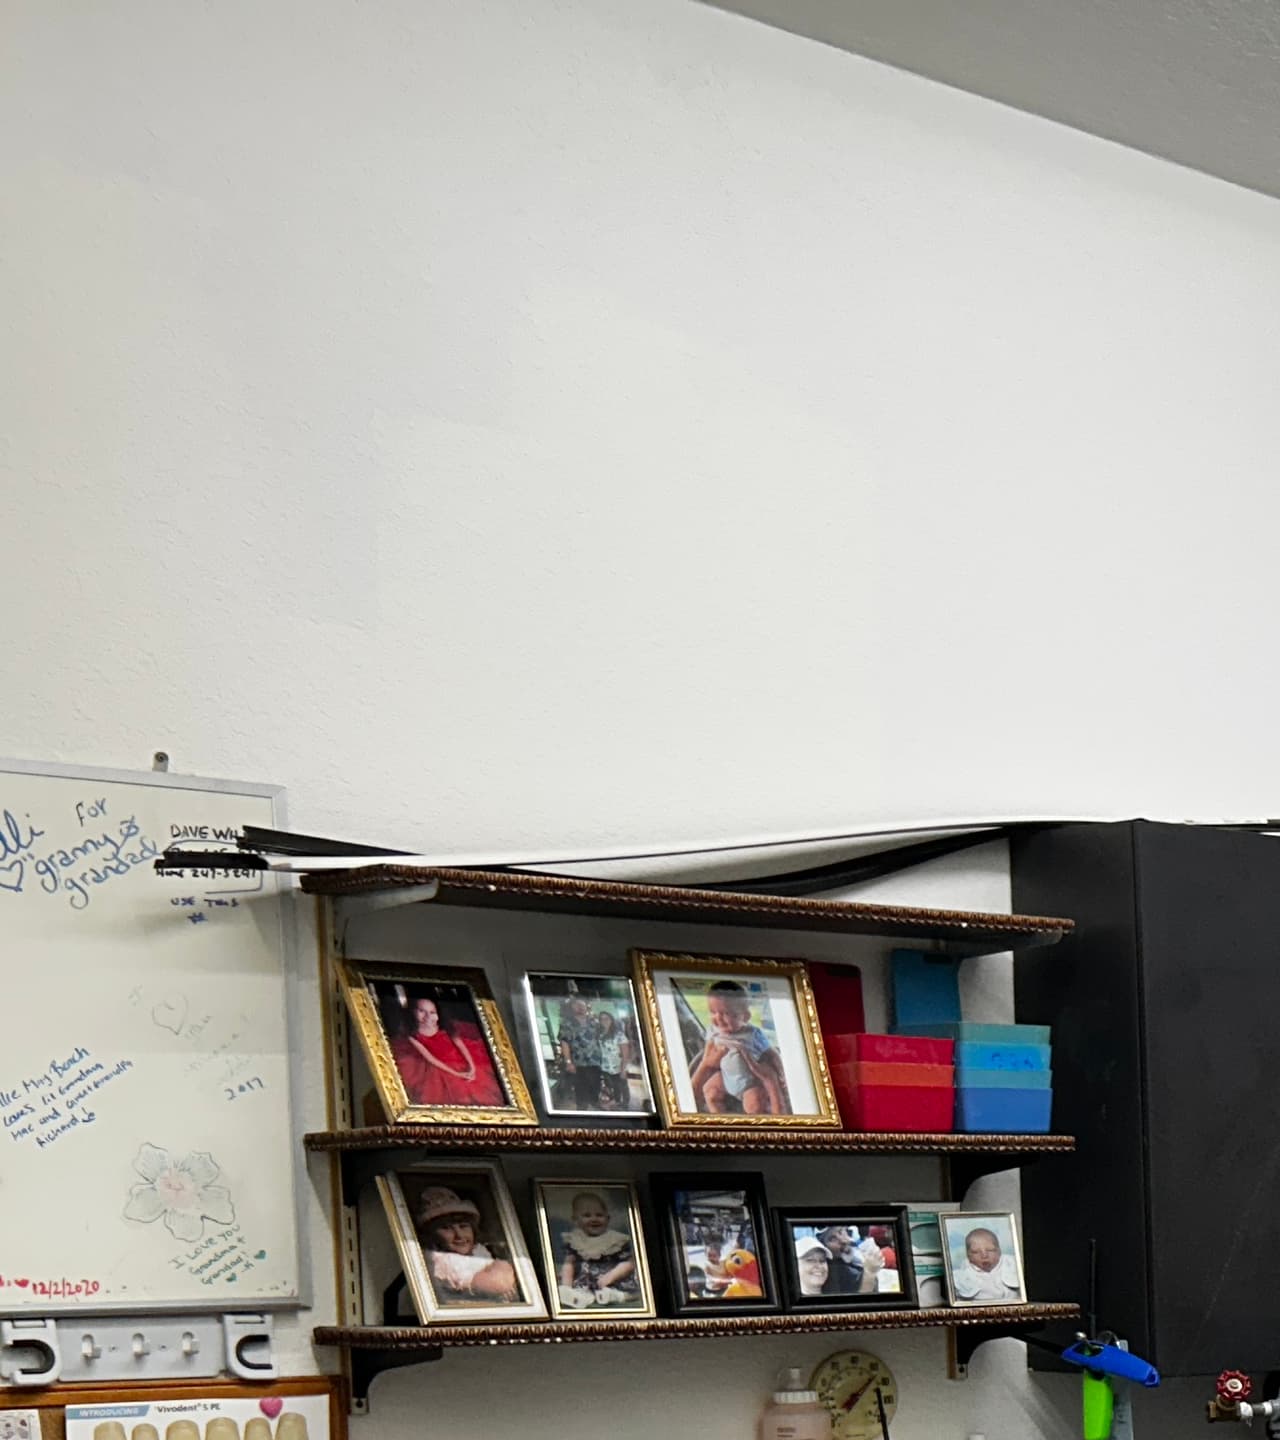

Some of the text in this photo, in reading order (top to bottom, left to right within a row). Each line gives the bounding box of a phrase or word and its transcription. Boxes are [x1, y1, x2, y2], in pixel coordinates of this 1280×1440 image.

[170, 824, 239, 840] DAVE WH
[32, 1276, 100, 1300] 12/2/2020
[79, 1407, 139, 1417] INTRODUCING
